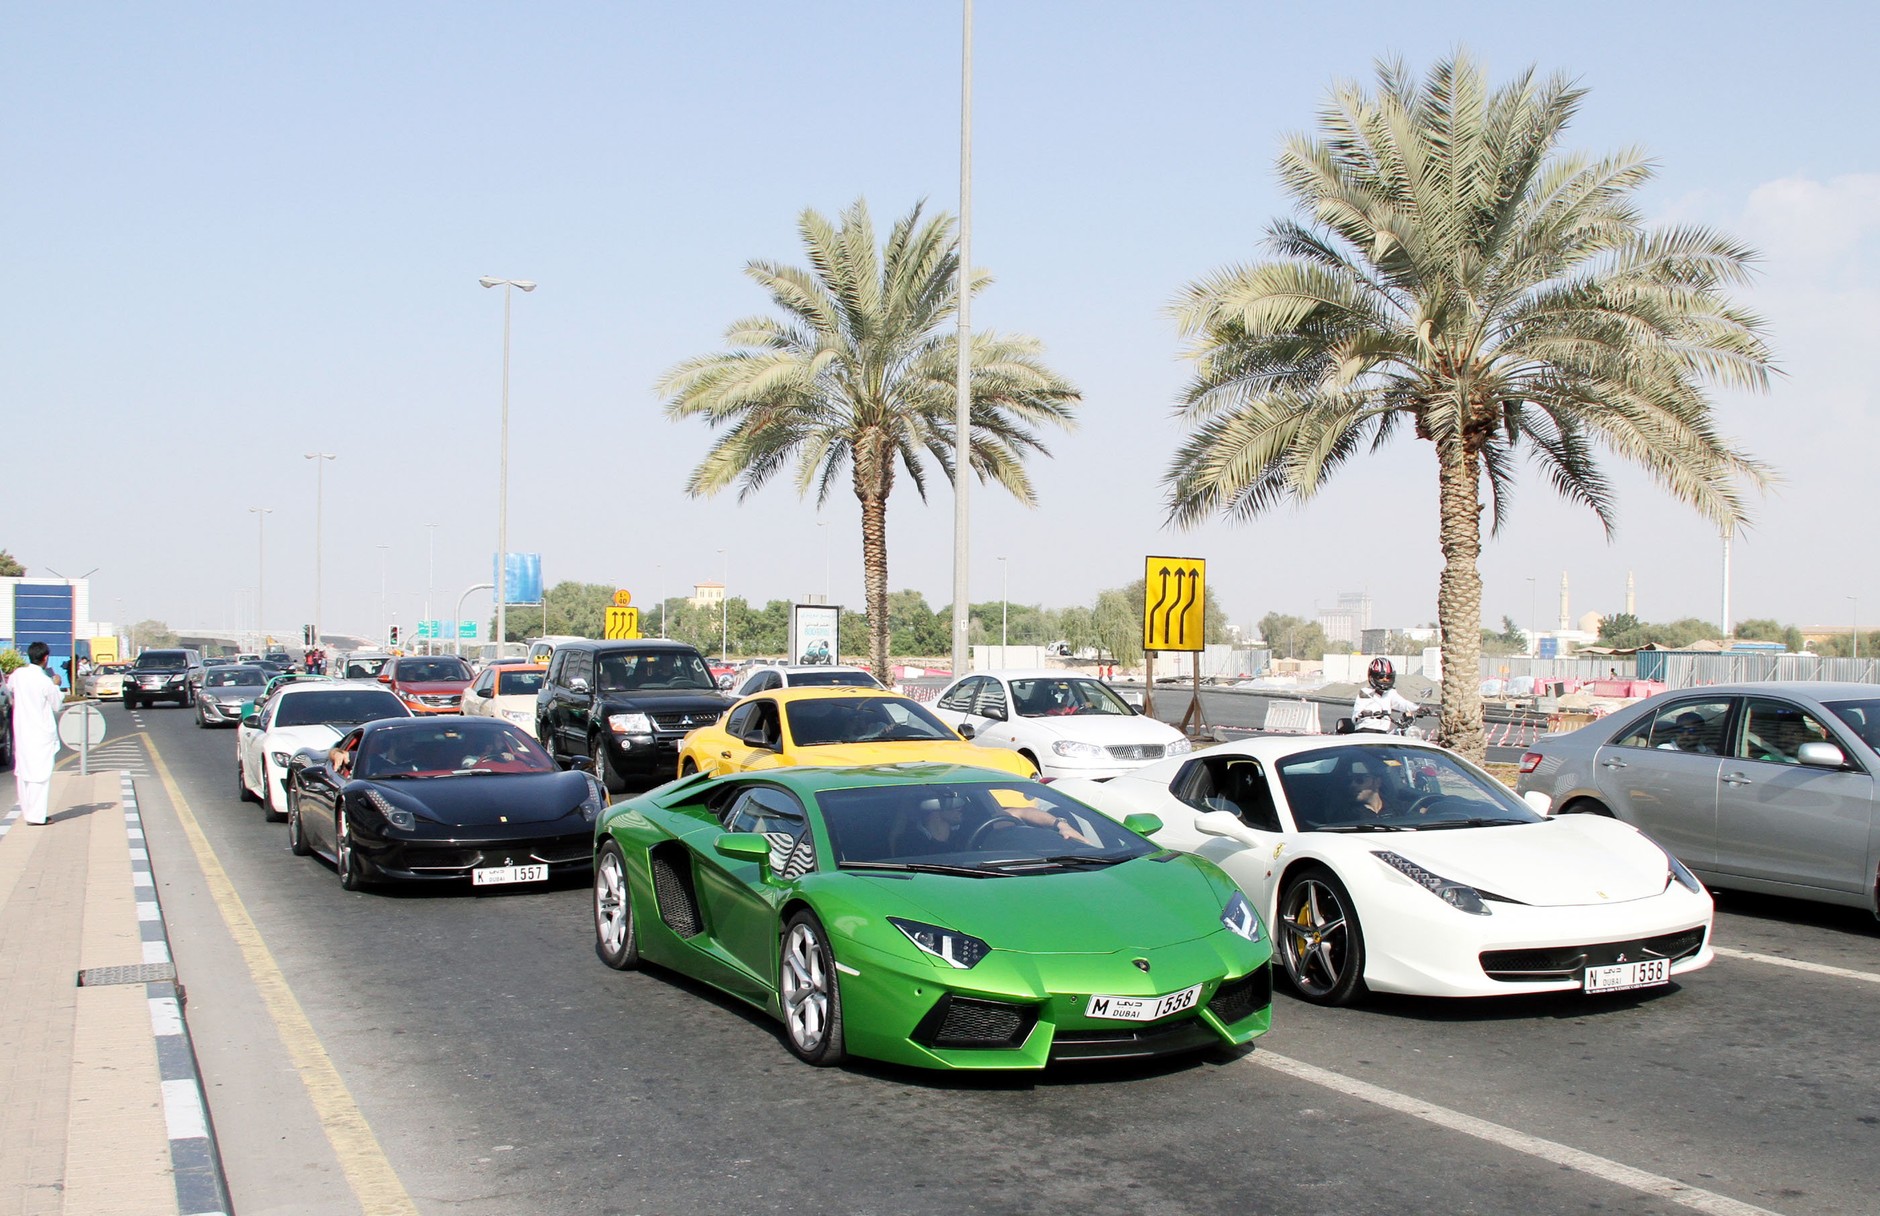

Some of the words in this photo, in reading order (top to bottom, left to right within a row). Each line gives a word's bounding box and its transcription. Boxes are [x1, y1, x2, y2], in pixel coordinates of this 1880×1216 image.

[477, 871, 484, 883] K
[514, 866, 542, 881] 1557
[1589, 970, 1598, 988] N
[1632, 961, 1663, 984] 1558
[1603, 977, 1622, 986] DUBAI
[1091, 998, 1110, 1015] M
[1154, 989, 1194, 1017] 1558
[1116, 1000, 1143, 1009] دبي
[1112, 1009, 1141, 1018] DUBAI
